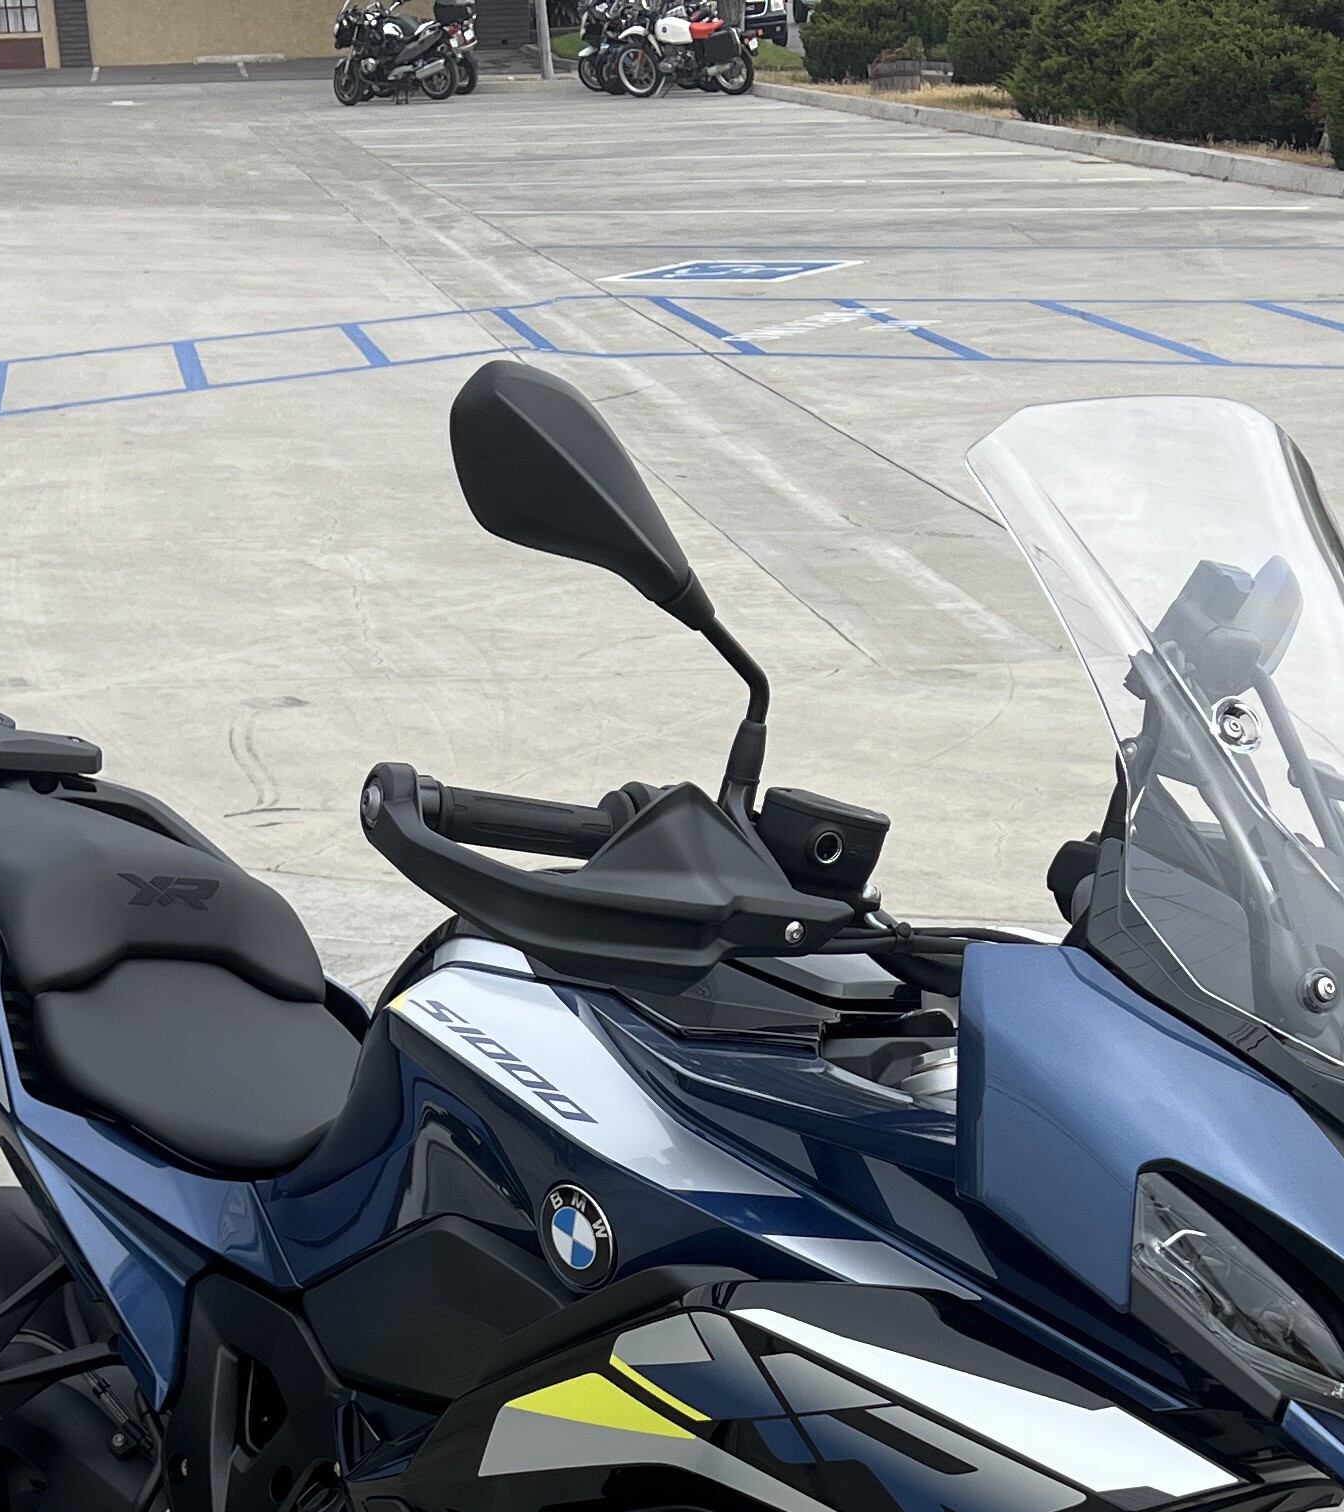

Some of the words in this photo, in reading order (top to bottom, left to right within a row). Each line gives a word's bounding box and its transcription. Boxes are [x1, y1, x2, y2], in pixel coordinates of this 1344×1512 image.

[117, 872, 220, 911] XR
[409, 998, 599, 1125] S1000
[549, 1190, 609, 1239] BMW
